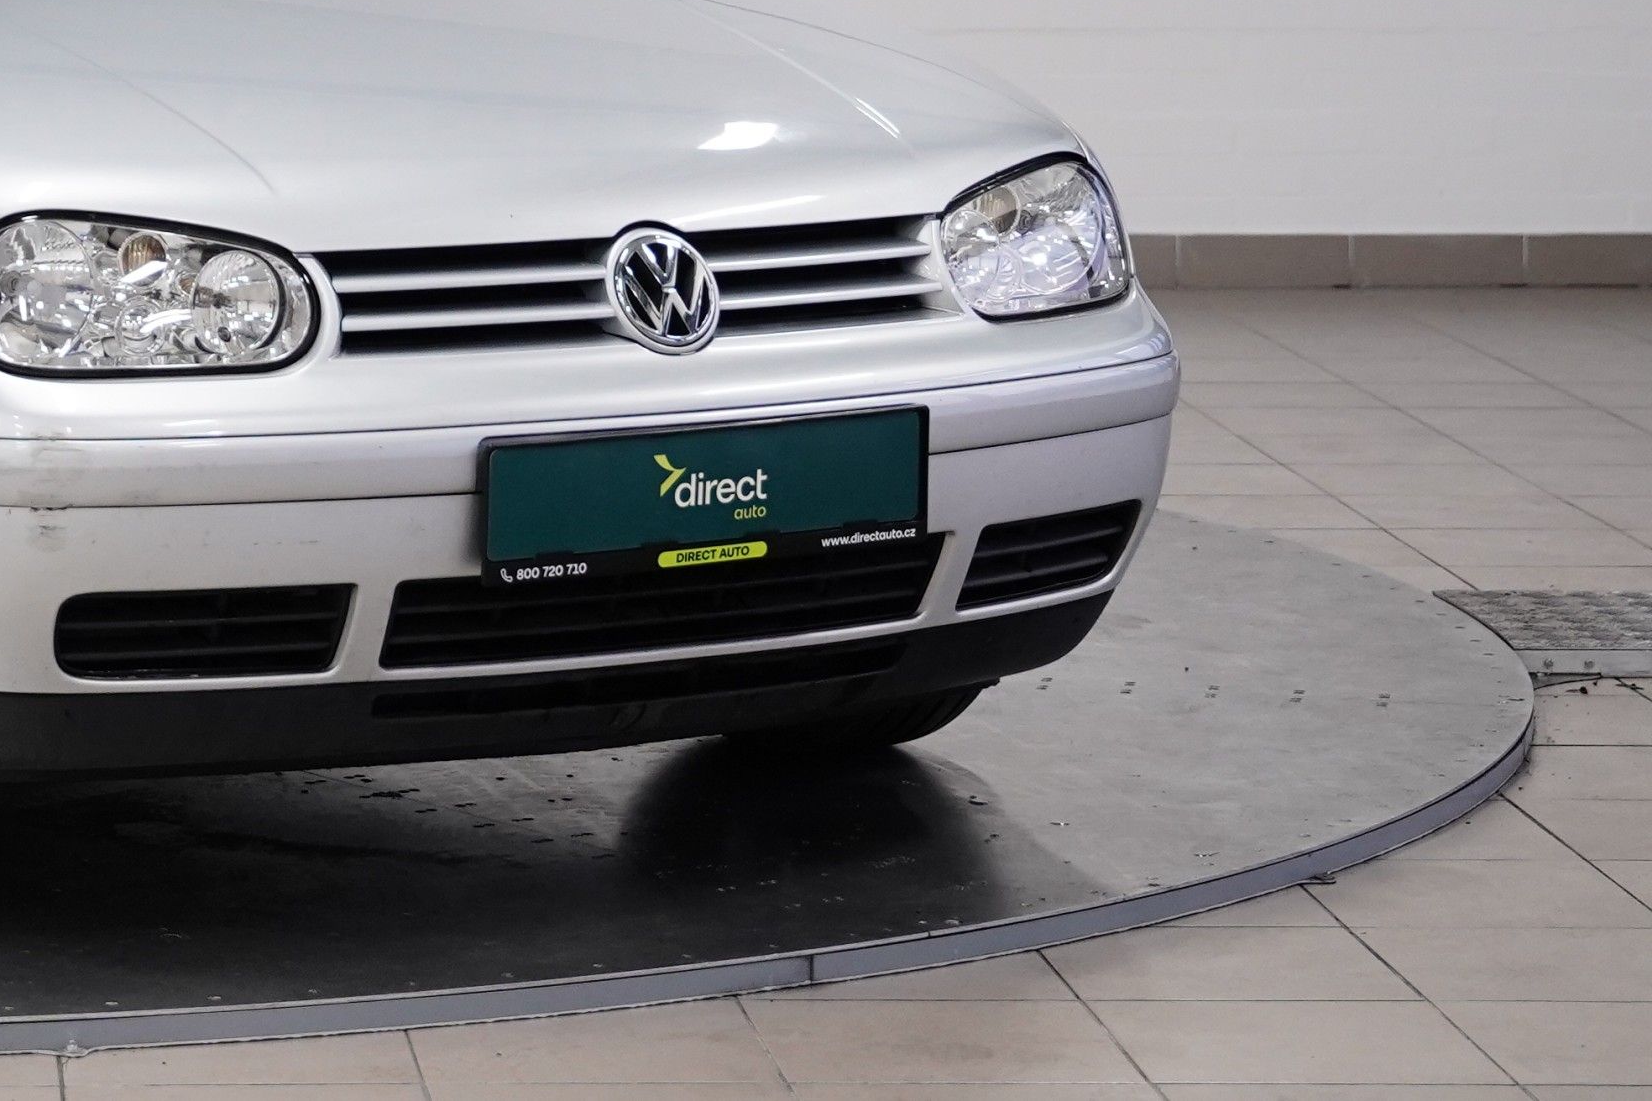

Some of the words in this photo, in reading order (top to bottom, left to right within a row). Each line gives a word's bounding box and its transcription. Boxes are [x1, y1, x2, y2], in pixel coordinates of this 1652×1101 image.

[674, 468, 768, 508] direct
[734, 504, 767, 520] auto
[821, 527, 916, 548] www.directauto.cz
[676, 549, 718, 564] DIRECT
[719, 545, 750, 559] AUTO
[516, 566, 540, 580] 800
[542, 564, 564, 578] 720
[566, 562, 588, 575] 710
